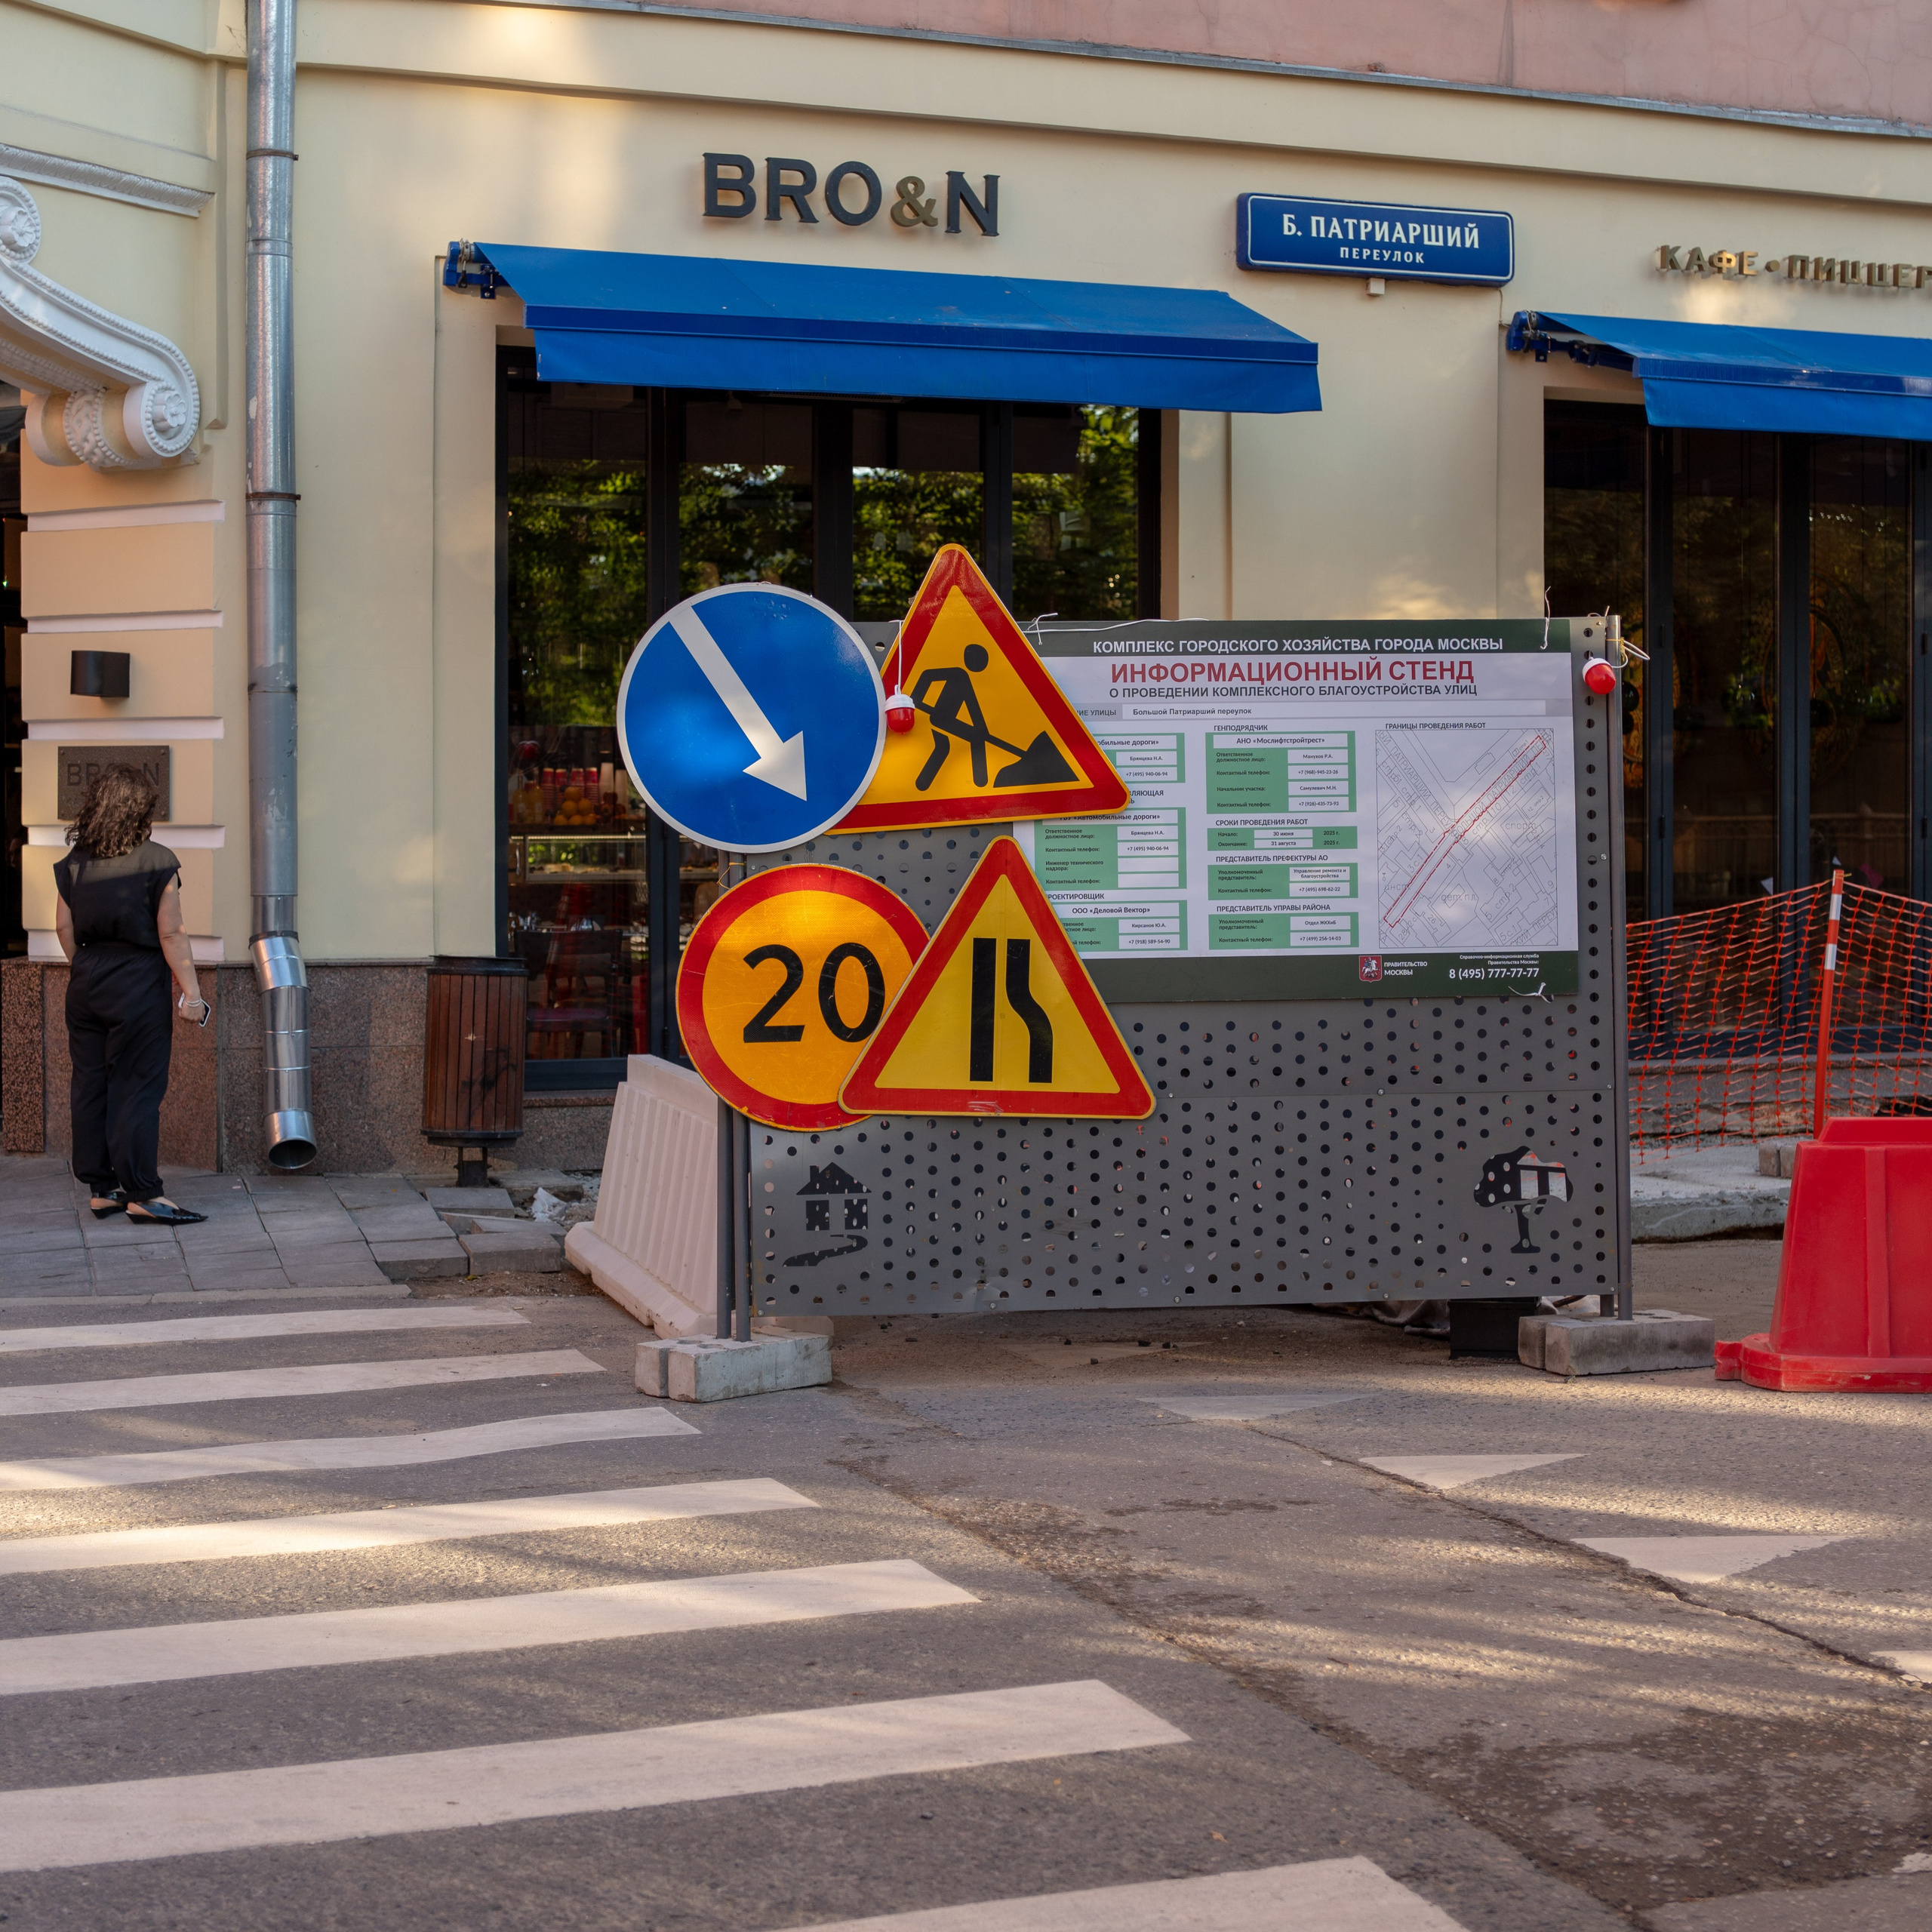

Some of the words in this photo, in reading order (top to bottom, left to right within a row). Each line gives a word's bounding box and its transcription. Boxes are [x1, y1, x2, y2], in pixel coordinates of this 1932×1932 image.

[702, 152, 1000, 237] BRO&N
[1283, 214, 1303, 237] Б.
[1311, 216, 1479, 249] ПАТРИАРШИЙ
[1340, 247, 1425, 263] ПЕРЕУЛОК
[1660, 245, 1758, 275] КАФЕ
[1093, 641, 1174, 654] КОМПЛЕКС
[1179, 640, 1278, 654] ГОРОДСКОГО
[1282, 637, 1371, 652] ХОЗЯЙСТВА
[1375, 639, 1434, 652] ГОРОДА
[1438, 638, 1503, 651] МОСКВЫ
[1112, 656, 1381, 685] ИНФОРМАЦИОННЫЙ
[1389, 660, 1474, 683] СТЕНД
[1109, 688, 1118, 698] О
[1122, 688, 1208, 699] ПРОВЕДЕНИИ
[1213, 686, 1315, 697] КОМПЛЕКСНОГО
[1319, 683, 1441, 697] БЛАГОУСТРОЙСТВА
[1444, 685, 1477, 696] УЛИЦ
[1169, 708, 1215, 716] Патриарший
[67, 762, 159, 786] BRN
[1090, 906, 1122, 915] «Деловой
[1449, 968, 1456, 979] 8
[1459, 968, 1484, 980] (495)
[1487, 968, 1540, 978] 777-77-77
[743, 942, 885, 1043] 20
